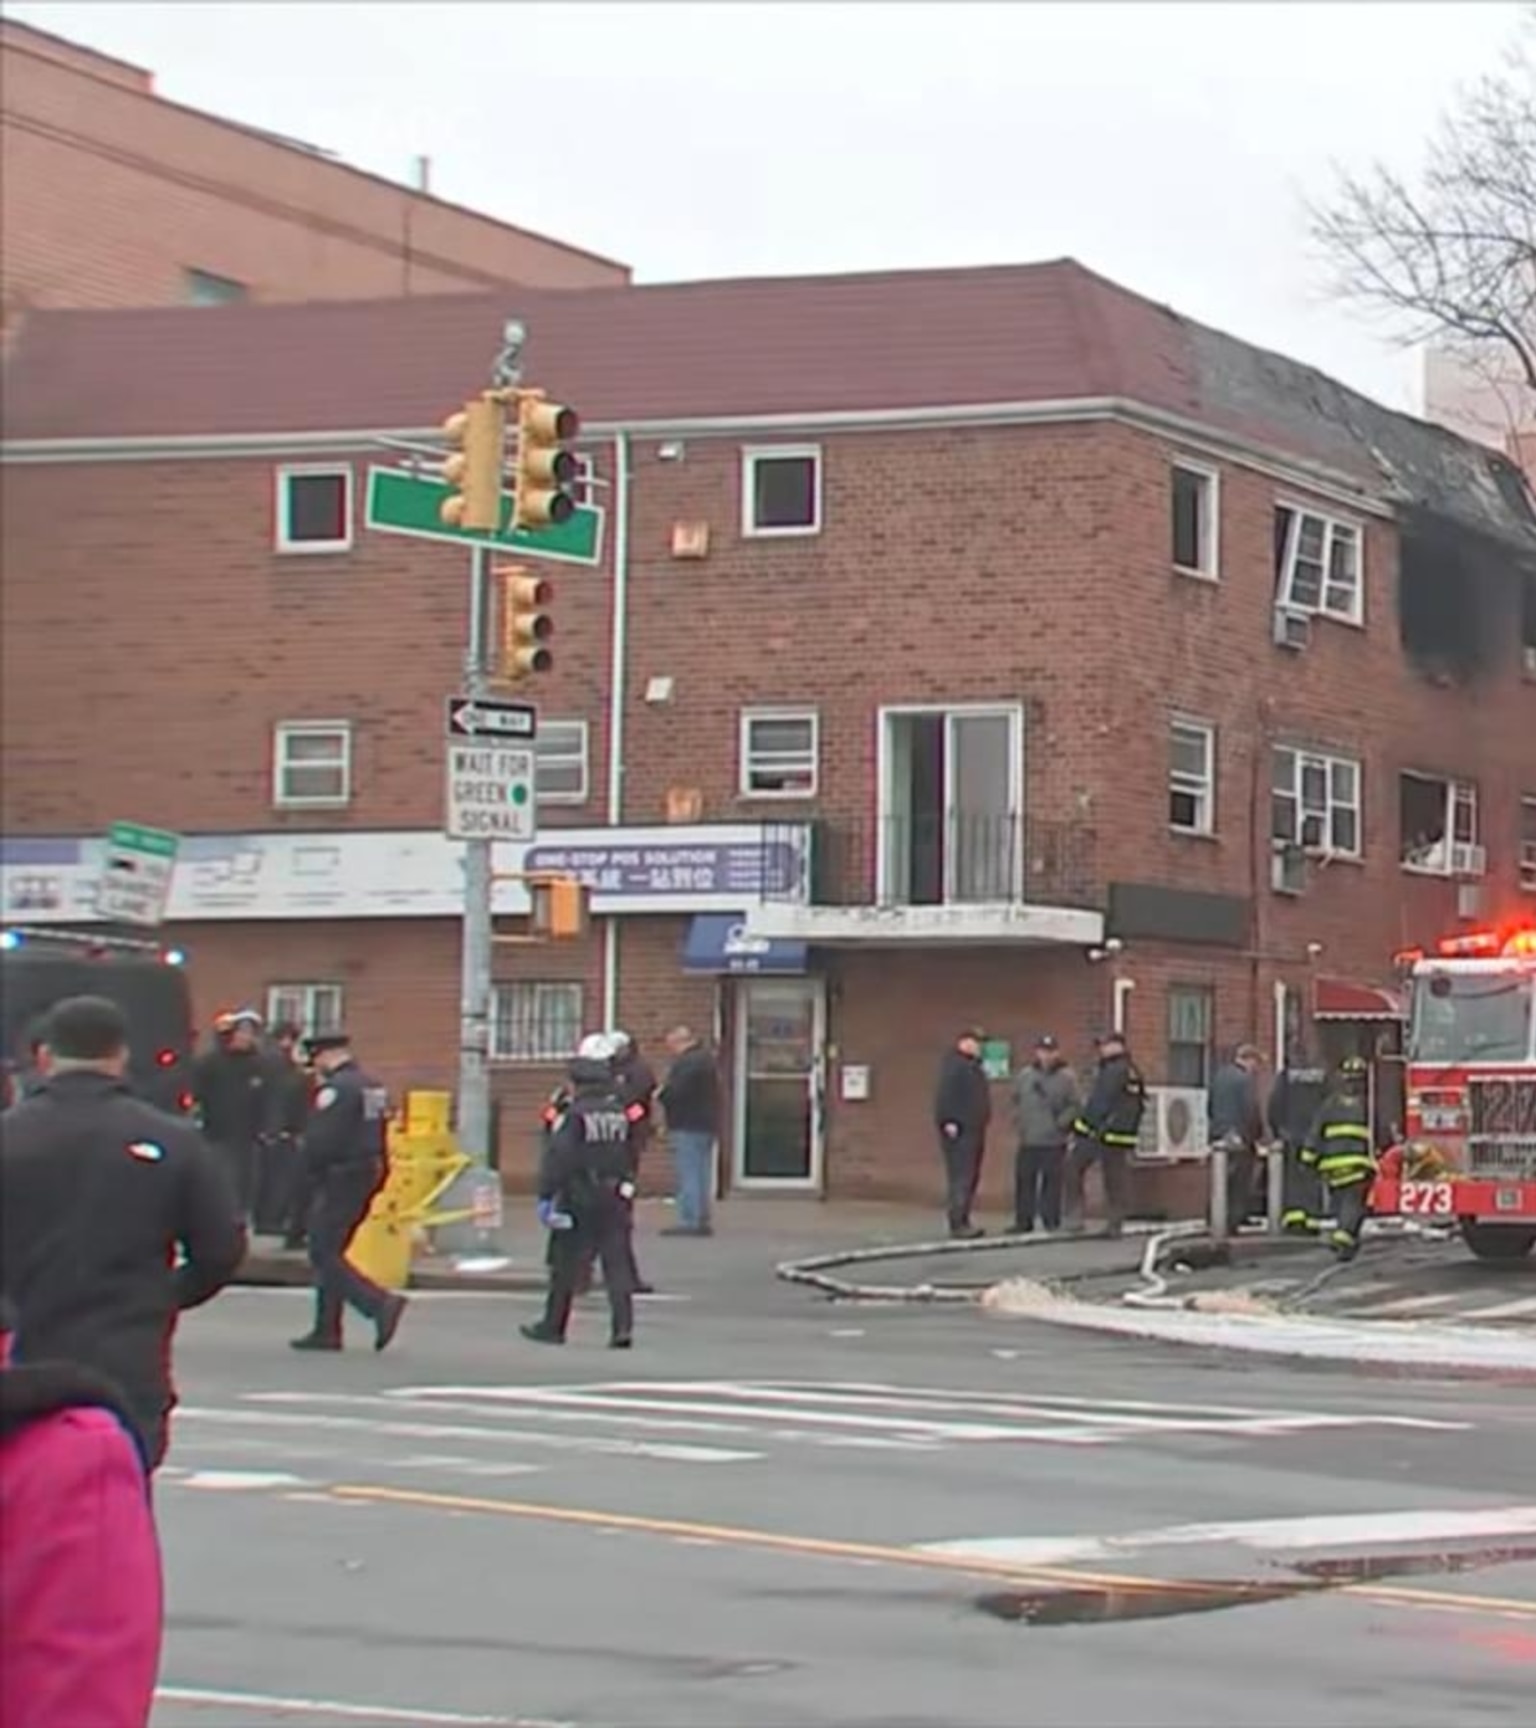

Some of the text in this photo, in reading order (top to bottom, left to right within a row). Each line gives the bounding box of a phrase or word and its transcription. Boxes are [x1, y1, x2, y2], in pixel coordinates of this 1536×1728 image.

[455, 752, 529, 777] WAIT FOR
[454, 780, 507, 803] GREEN
[460, 809, 523, 835] SIGNAL
[534, 849, 717, 868] ONE-STOP POS SOLUTION
[583, 1111, 629, 1142] NYPD
[1399, 1182, 1453, 1213] 273
